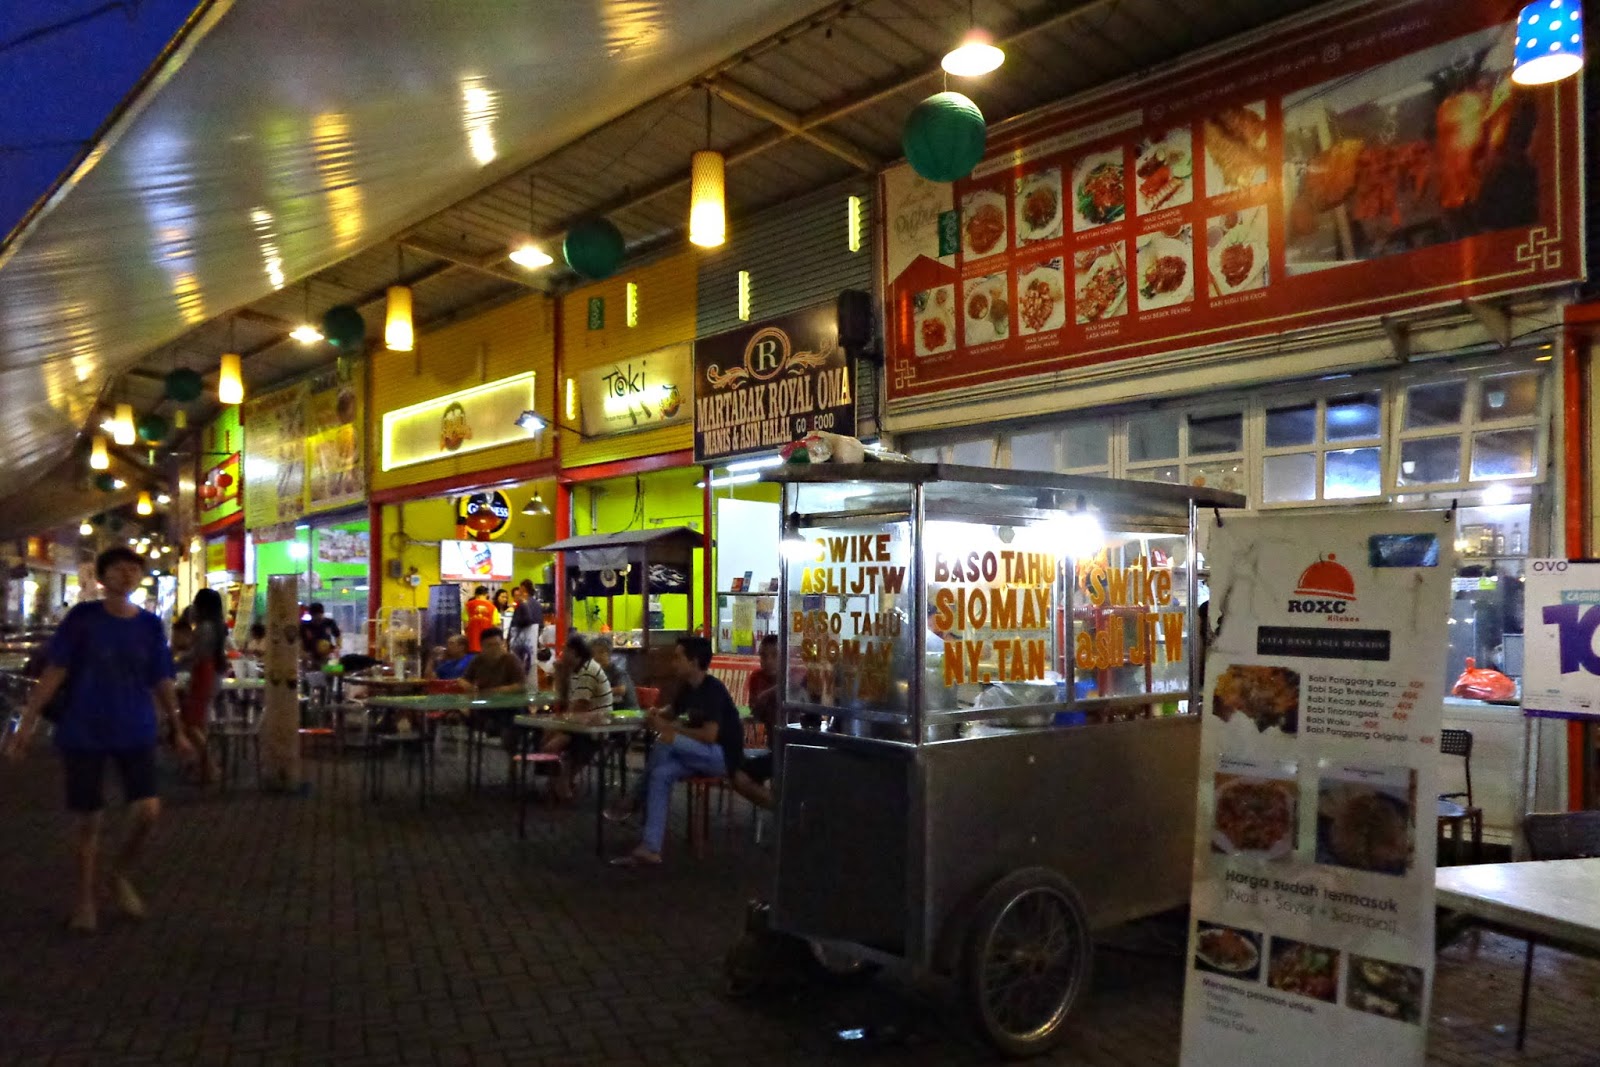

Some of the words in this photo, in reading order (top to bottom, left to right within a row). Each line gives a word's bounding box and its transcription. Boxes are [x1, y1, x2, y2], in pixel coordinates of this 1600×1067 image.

[697, 384, 766, 432] MARTABAK
[768, 375, 813, 419] ROYAL
[817, 366, 851, 410] OMA
[740, 420, 761, 447] ASIN
[762, 416, 792, 445] HALAL
[795, 419, 806, 433] GO
[814, 412, 834, 429] FOOD
[814, 534, 891, 563] SWIKE
[935, 550, 998, 583] BASO
[1001, 551, 1055, 584] TAHU
[1533, 561, 1568, 571] OVO
[934, 587, 1050, 632] SIOMAY
[1288, 600, 1346, 613] ROXC
[793, 611, 842, 635] BASO
[851, 611, 901, 637] TAHU
[1316, 638, 1338, 647] ASLI
[1308, 675, 1327, 683] Babi
[1329, 676, 1374, 688] Panggang
[1376, 678, 1396, 687] Rica
[1308, 685, 1326, 693] Babi
[1307, 695, 1325, 703] Babi
[1328, 697, 1356, 707] Kecap
[1306, 716, 1324, 724] Babi
[1327, 717, 1350, 726] Woku
[1306, 726, 1324, 734] Babi
[1326, 728, 1370, 740] Panggang
[1373, 732, 1408, 742] Original
[1226, 871, 1269, 889] Harga
[1273, 880, 1318, 897] sudah
[1324, 889, 1398, 913] termasuk
